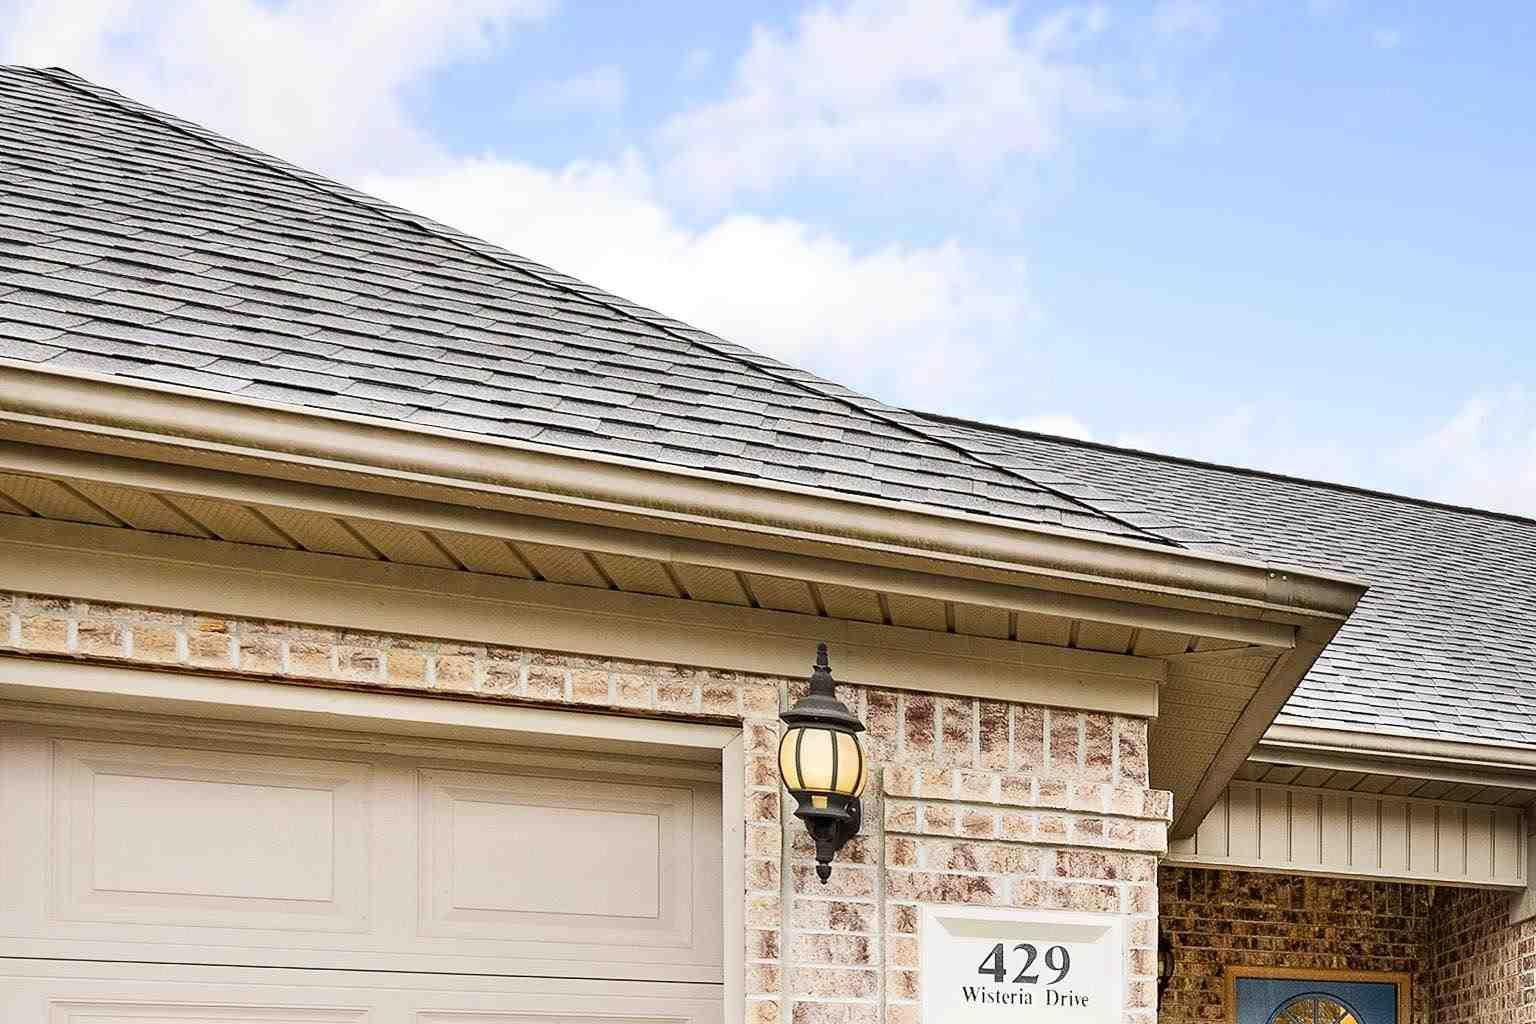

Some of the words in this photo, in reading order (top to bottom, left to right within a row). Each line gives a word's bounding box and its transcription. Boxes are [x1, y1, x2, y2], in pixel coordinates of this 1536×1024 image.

[977, 943, 1071, 985] 429
[962, 986, 1033, 1005] Wisteria
[1046, 989, 1089, 1007] Drive
